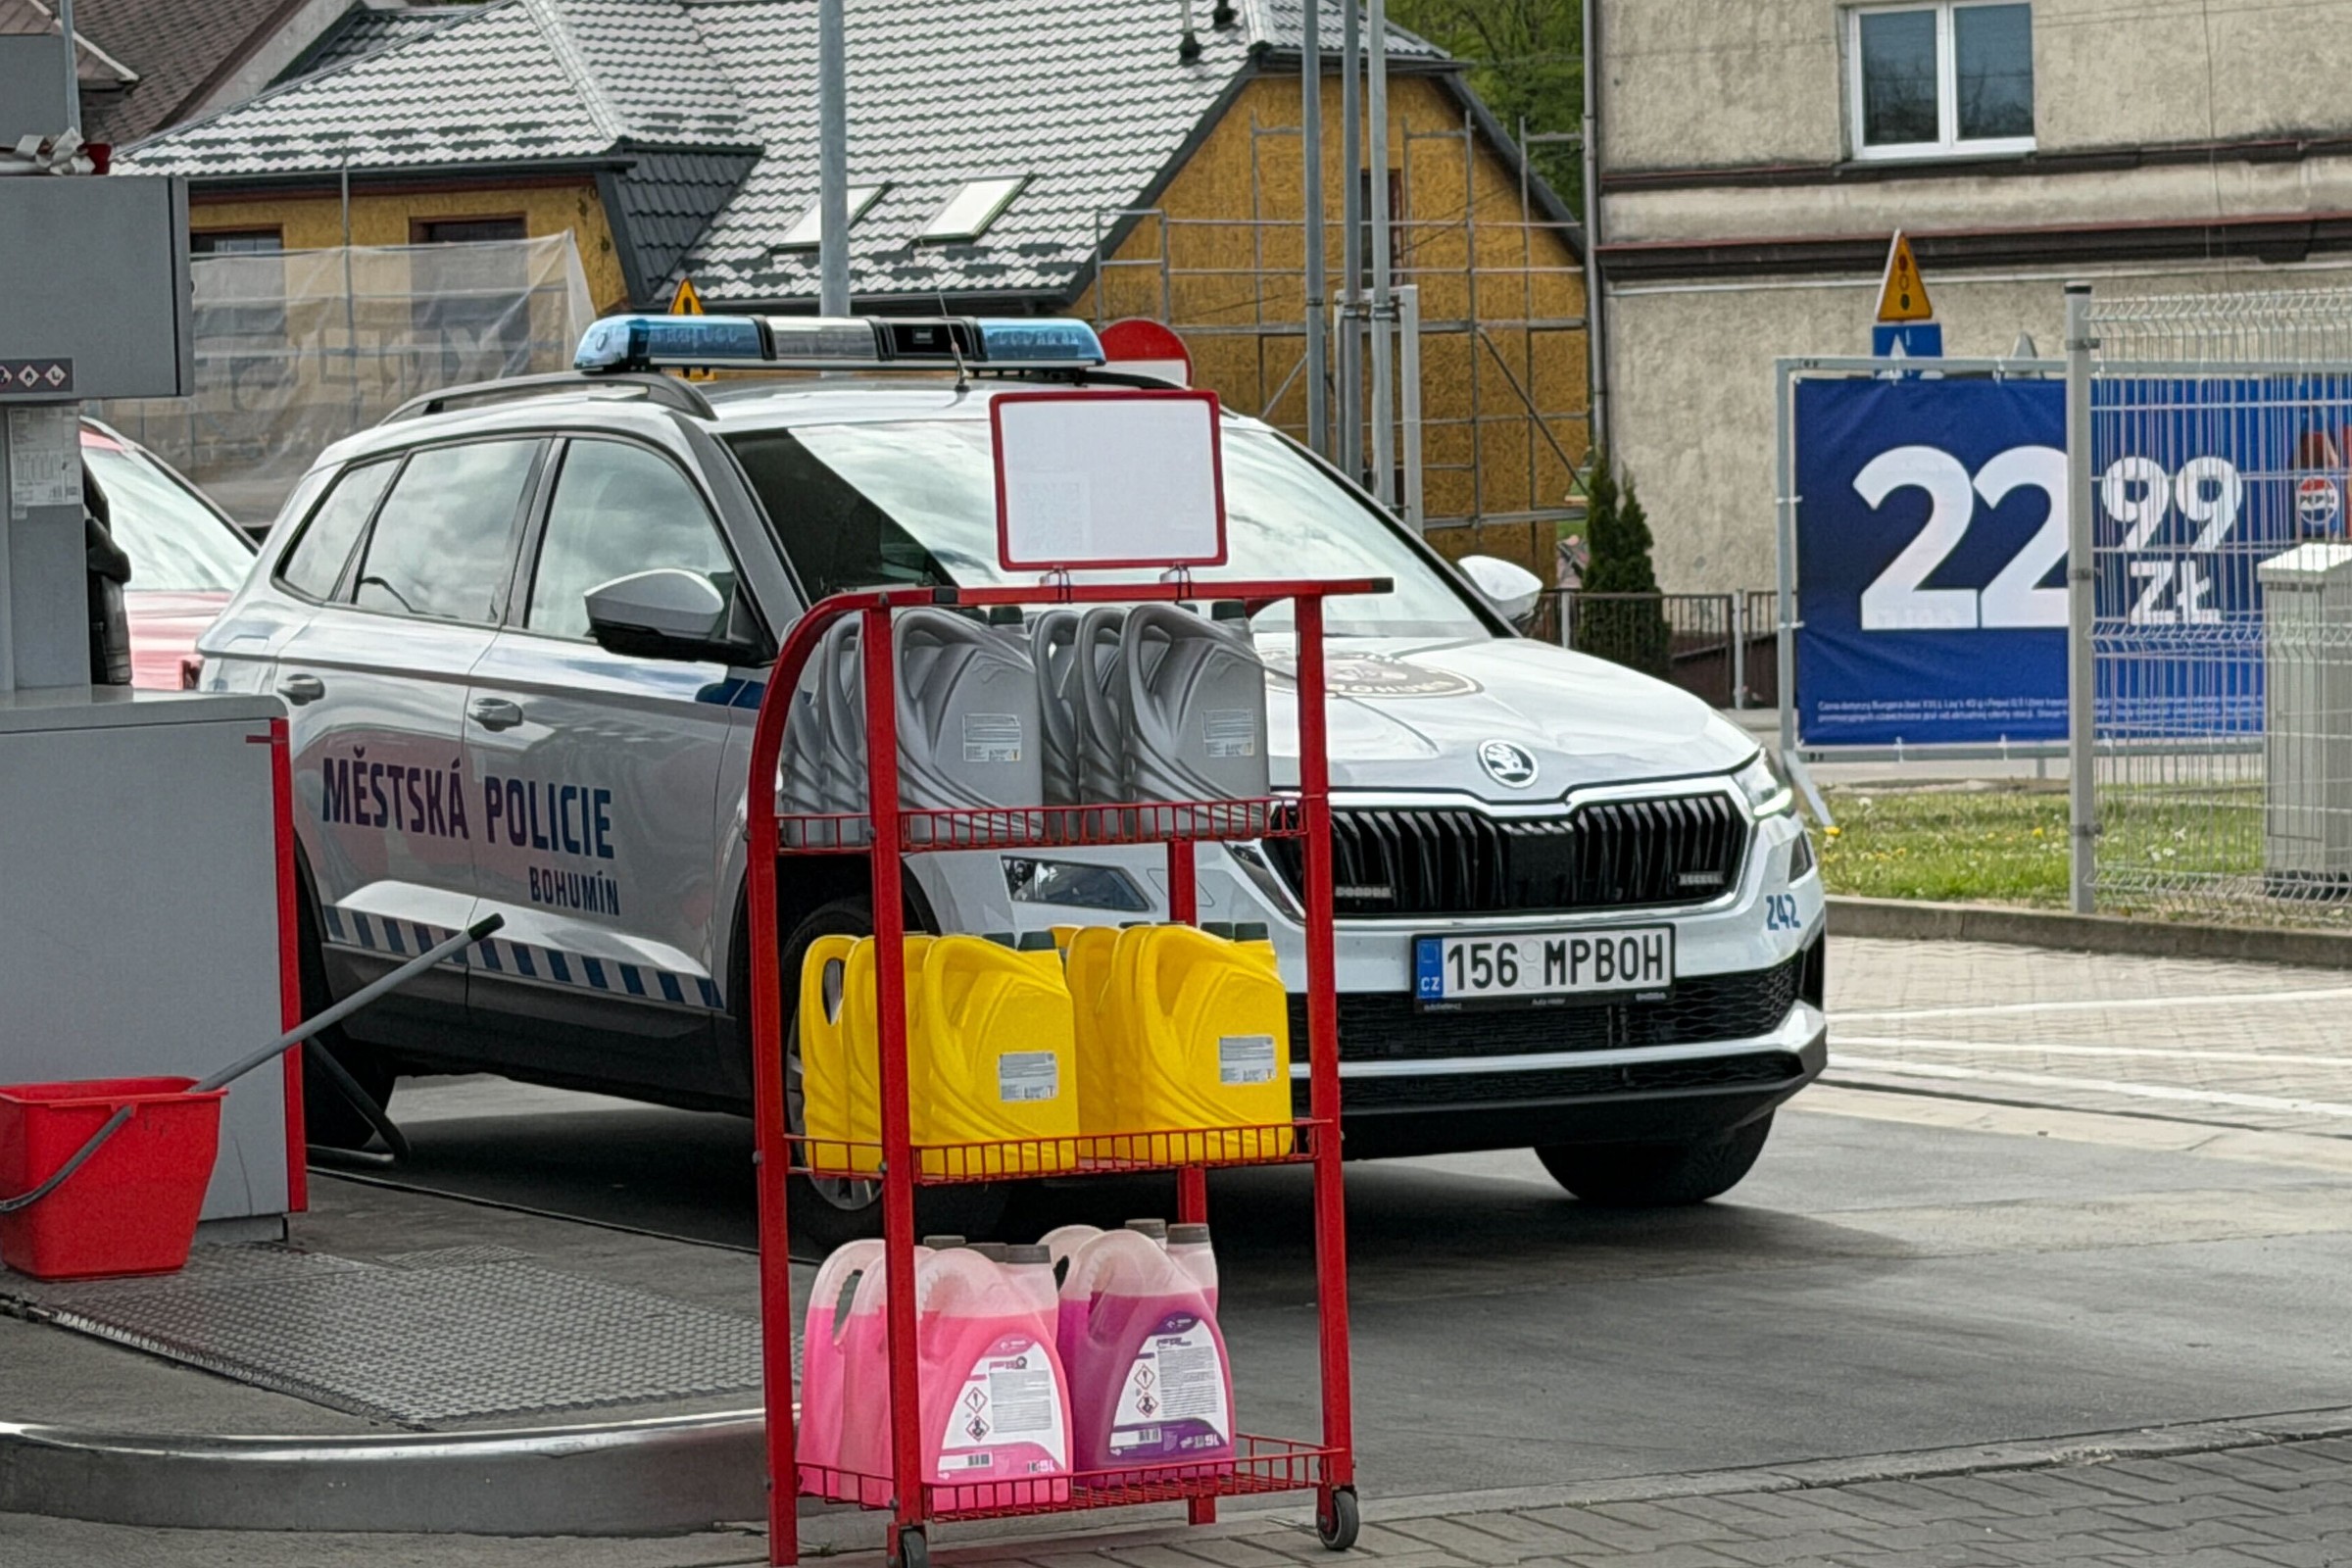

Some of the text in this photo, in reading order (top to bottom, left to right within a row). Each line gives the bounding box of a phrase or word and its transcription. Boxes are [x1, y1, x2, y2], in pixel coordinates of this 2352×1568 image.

[1852, 445, 2242, 630] 22 99
[2130, 560, 2223, 625] ZŁ
[322, 745, 615, 859] MĚSTSKÁ POLICIE
[528, 865, 620, 916] BOHUMÍN
[1765, 893, 1802, 931] 242
[1420, 976, 1441, 992] CZ
[1446, 934, 1664, 991] 156 MPBOH
